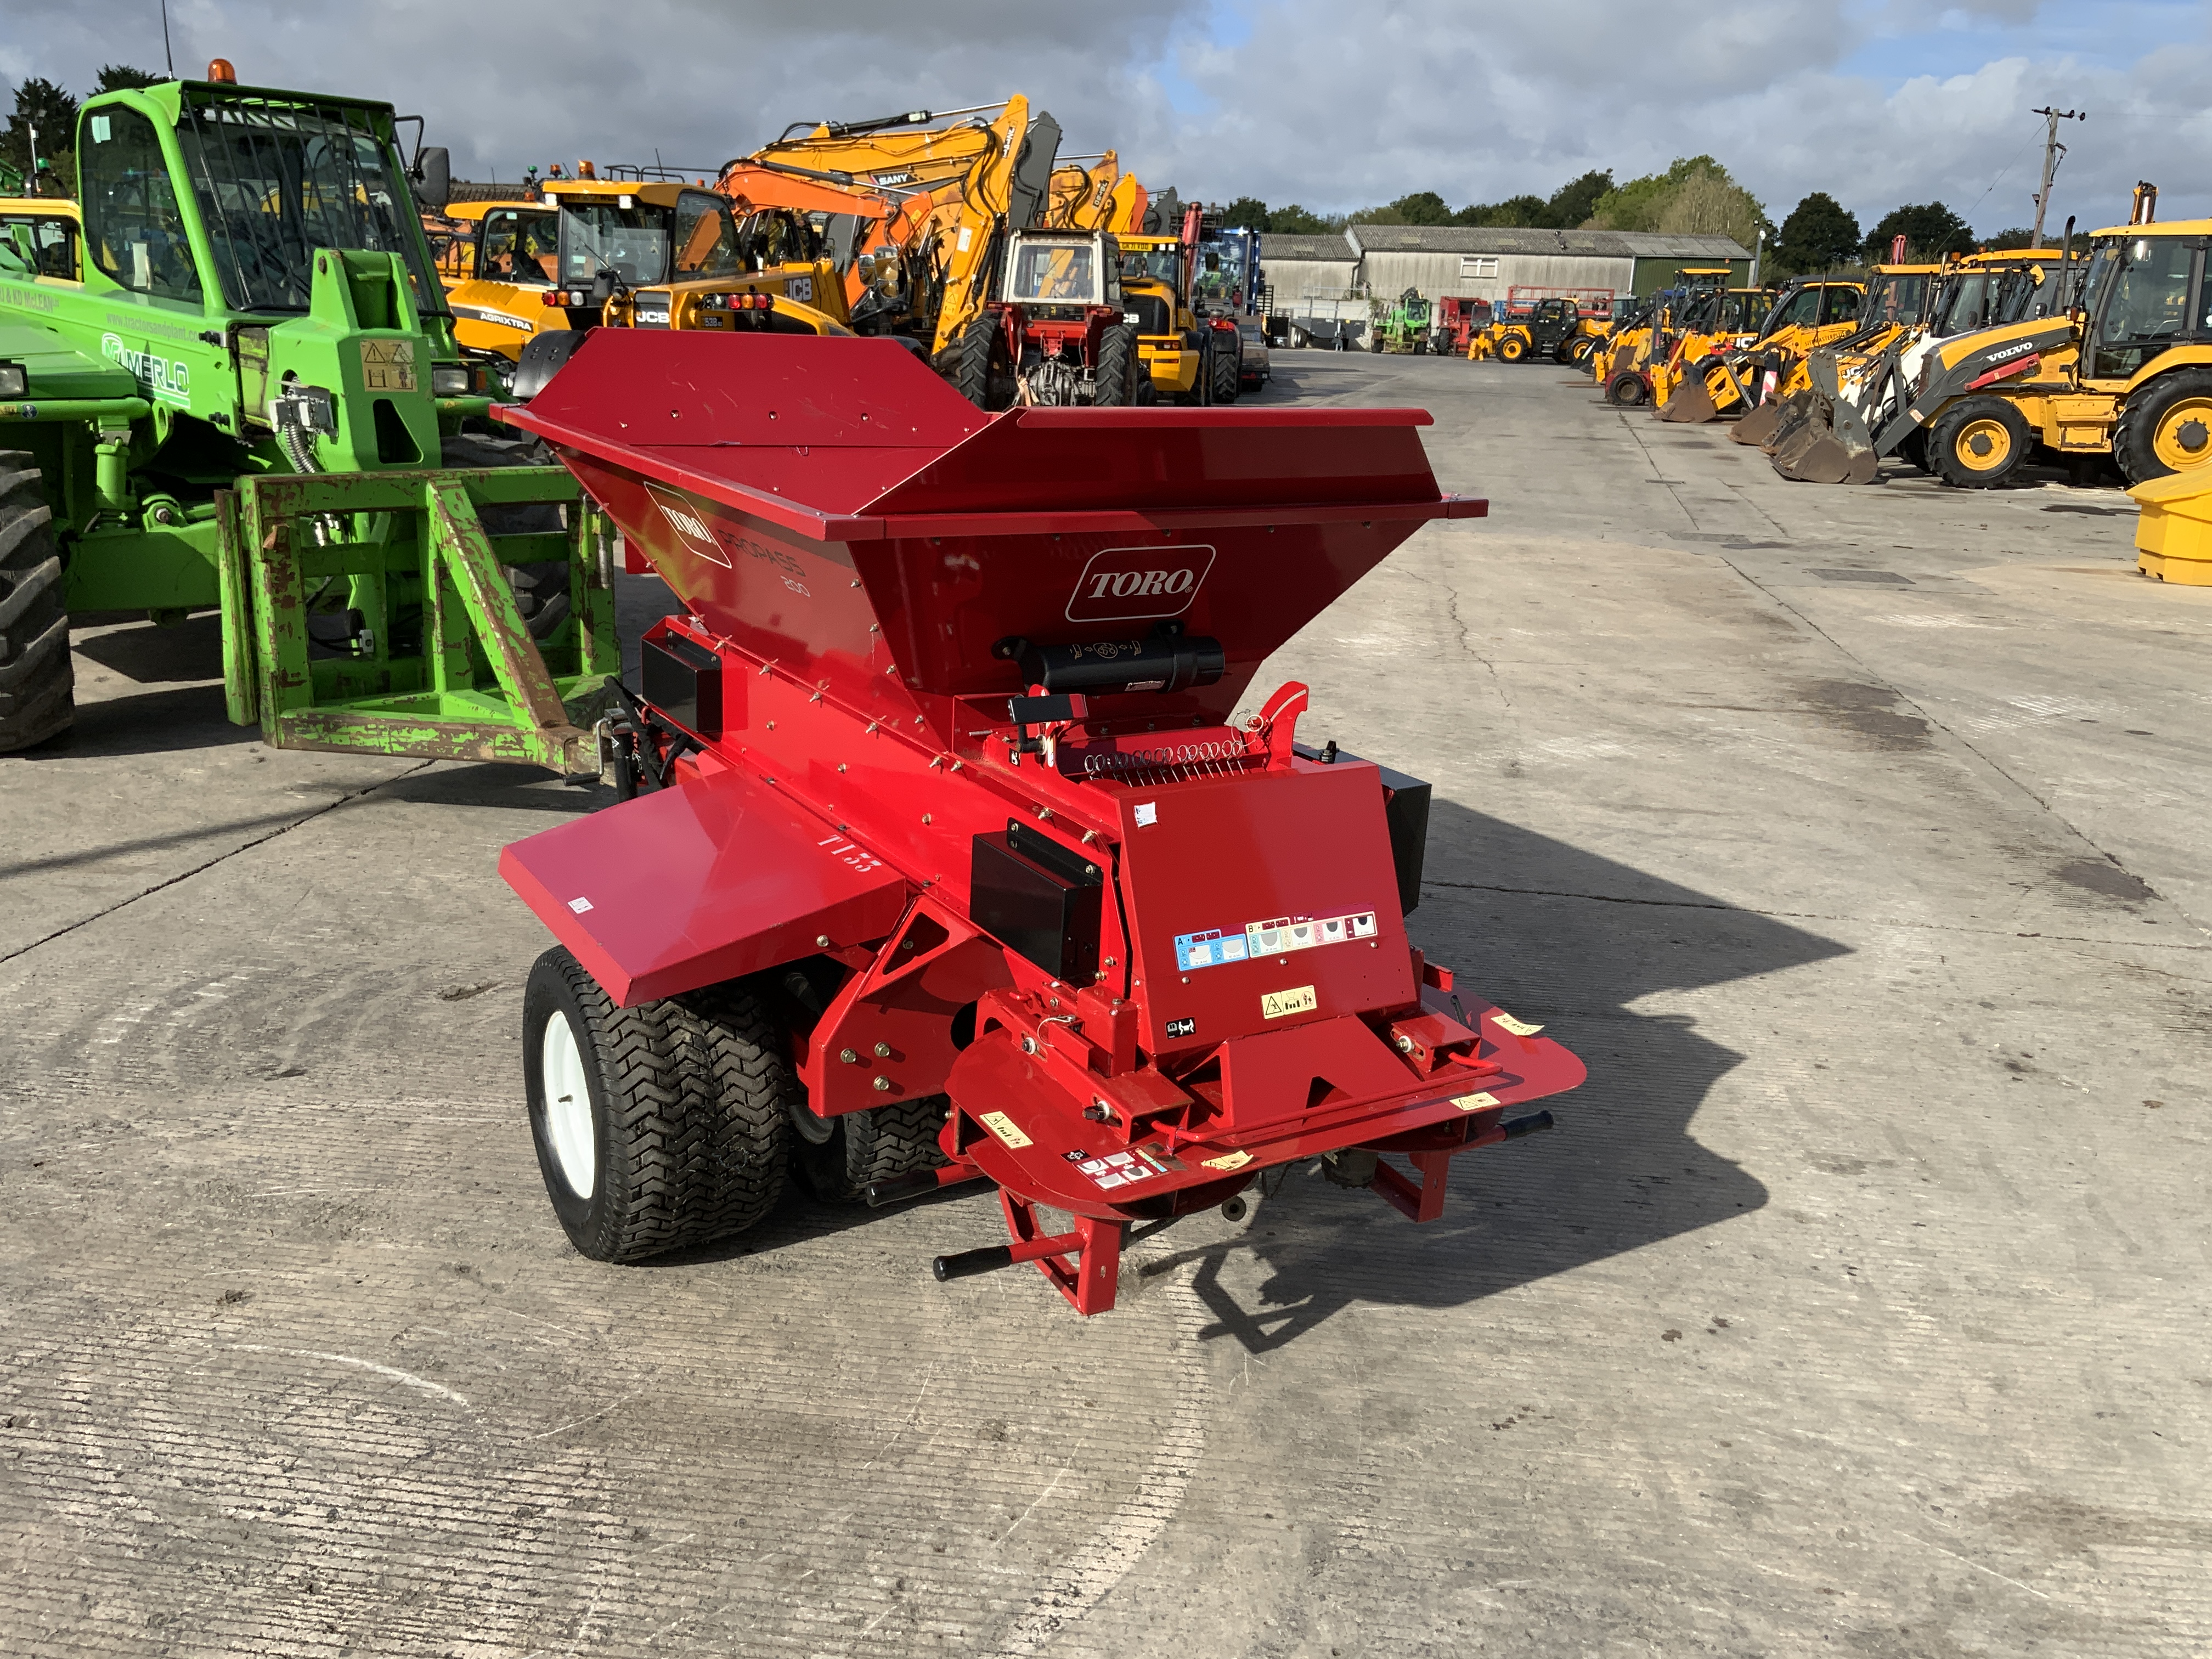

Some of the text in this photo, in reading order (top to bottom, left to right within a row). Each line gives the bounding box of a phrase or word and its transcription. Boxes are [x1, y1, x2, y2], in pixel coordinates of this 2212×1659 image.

[879, 174, 909, 185] SANY
[785, 278, 812, 301] JCB
[480, 312, 532, 330] AGRIXTRA
[636, 311, 669, 323] JCB
[1123, 313, 1139, 323] CB
[1730, 337, 1757, 348] JC
[1987, 342, 2033, 362] VOLVO
[126, 349, 189, 395] MERLO
[661, 505, 712, 543] TORO
[718, 529, 805, 577] PROPASS
[781, 575, 810, 597] 200
[1088, 569, 1193, 599] TORO
